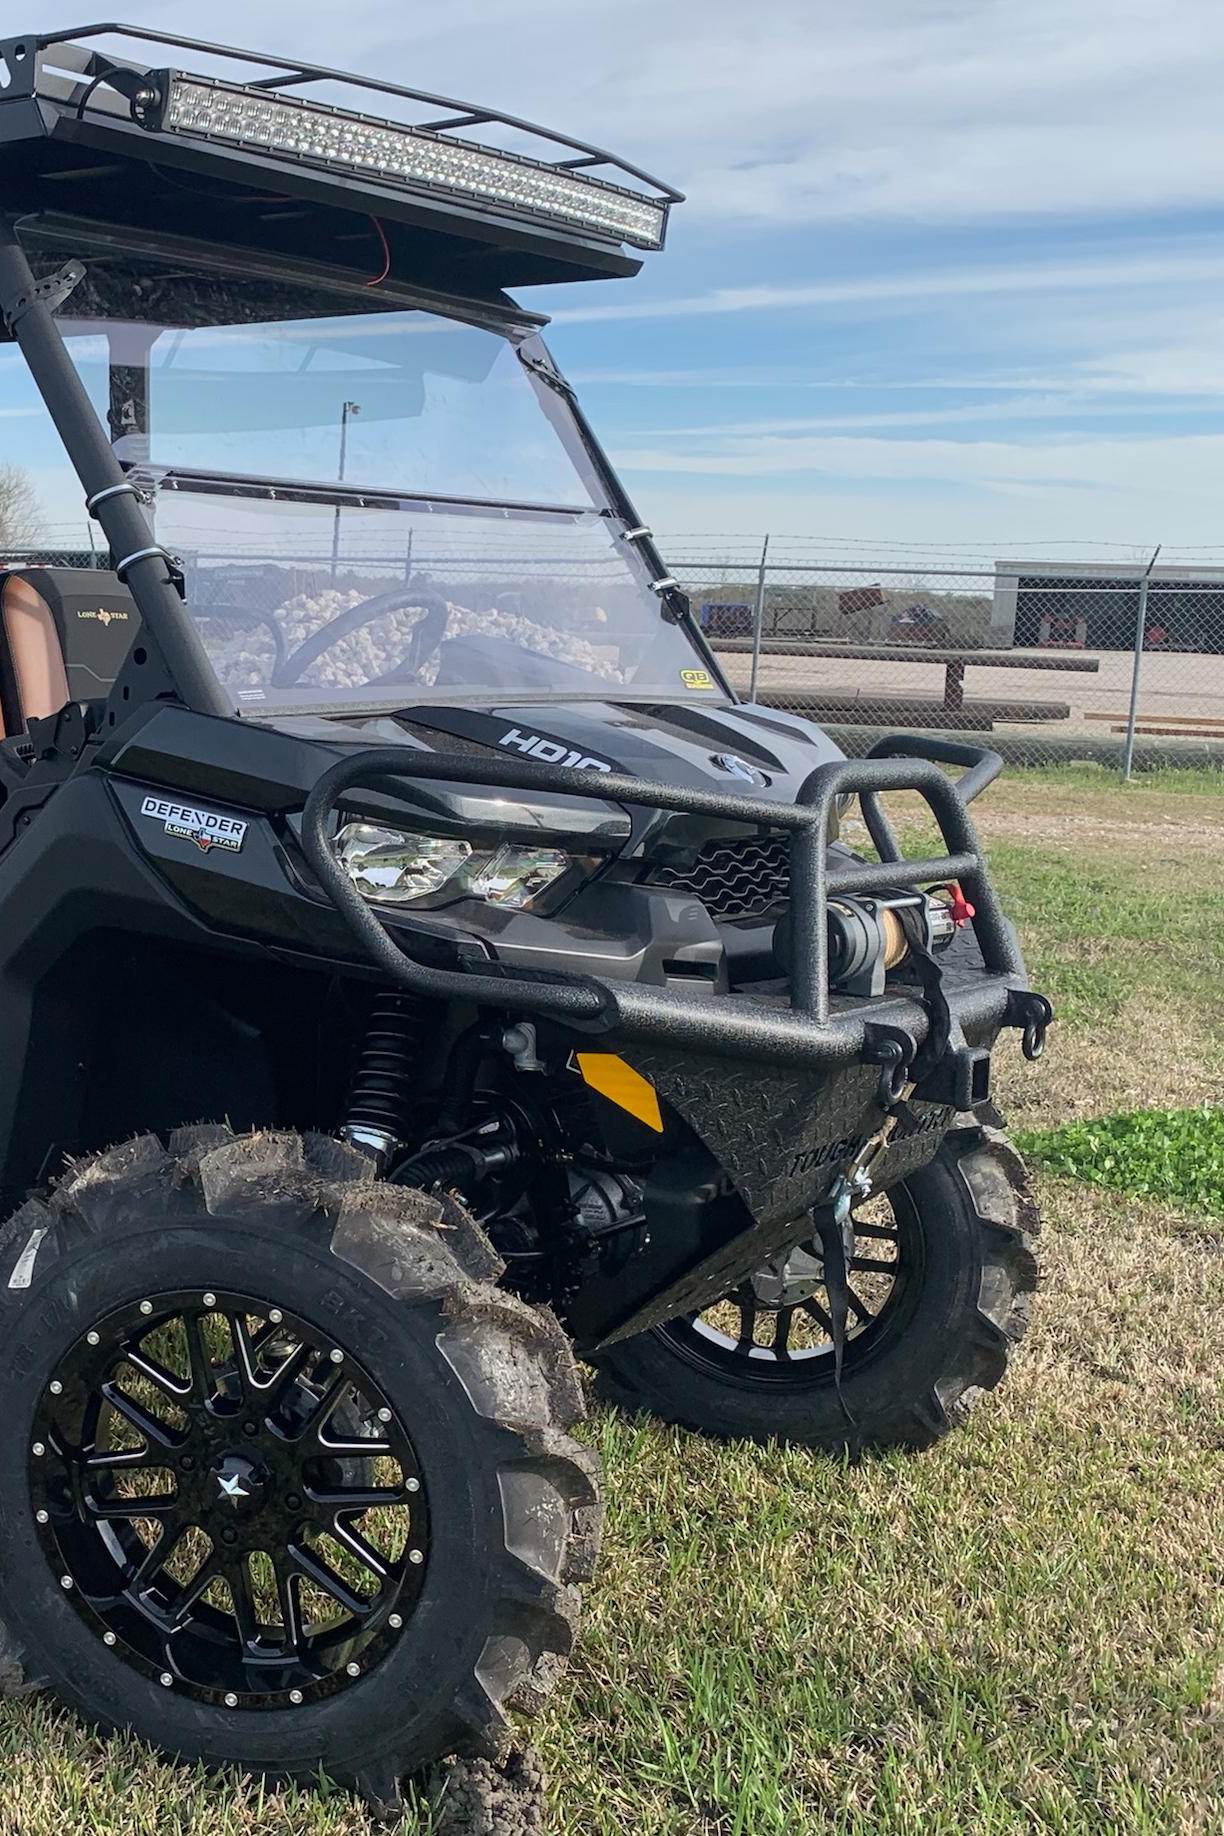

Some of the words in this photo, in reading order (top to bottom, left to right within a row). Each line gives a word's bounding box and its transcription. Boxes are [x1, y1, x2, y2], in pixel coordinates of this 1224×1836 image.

[77, 610, 97, 619] LONE
[110, 612, 129, 620] STAR
[144, 799, 245, 836] DEFENDER
[167, 824, 194, 837] LONE
[211, 836, 239, 849] STAR
